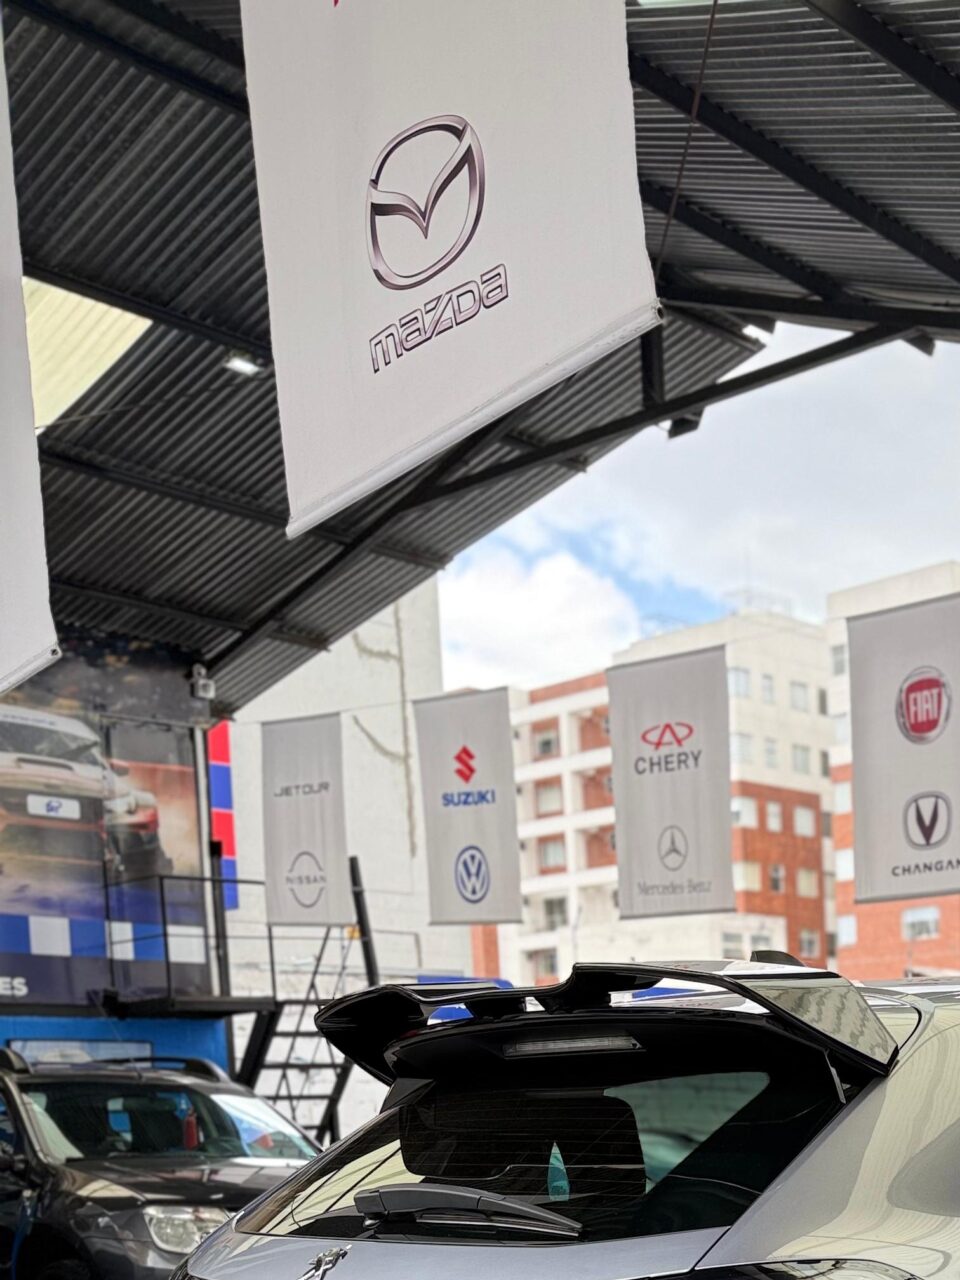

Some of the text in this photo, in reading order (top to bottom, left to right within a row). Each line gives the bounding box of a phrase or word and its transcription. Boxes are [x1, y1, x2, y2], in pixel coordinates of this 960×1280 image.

[908, 687, 941, 725] FIAT
[634, 749, 703, 775] CHERY
[273, 781, 330, 798] JETOUR
[441, 789, 496, 807] SUZUKI
[286, 874, 327, 886] NISSAN
